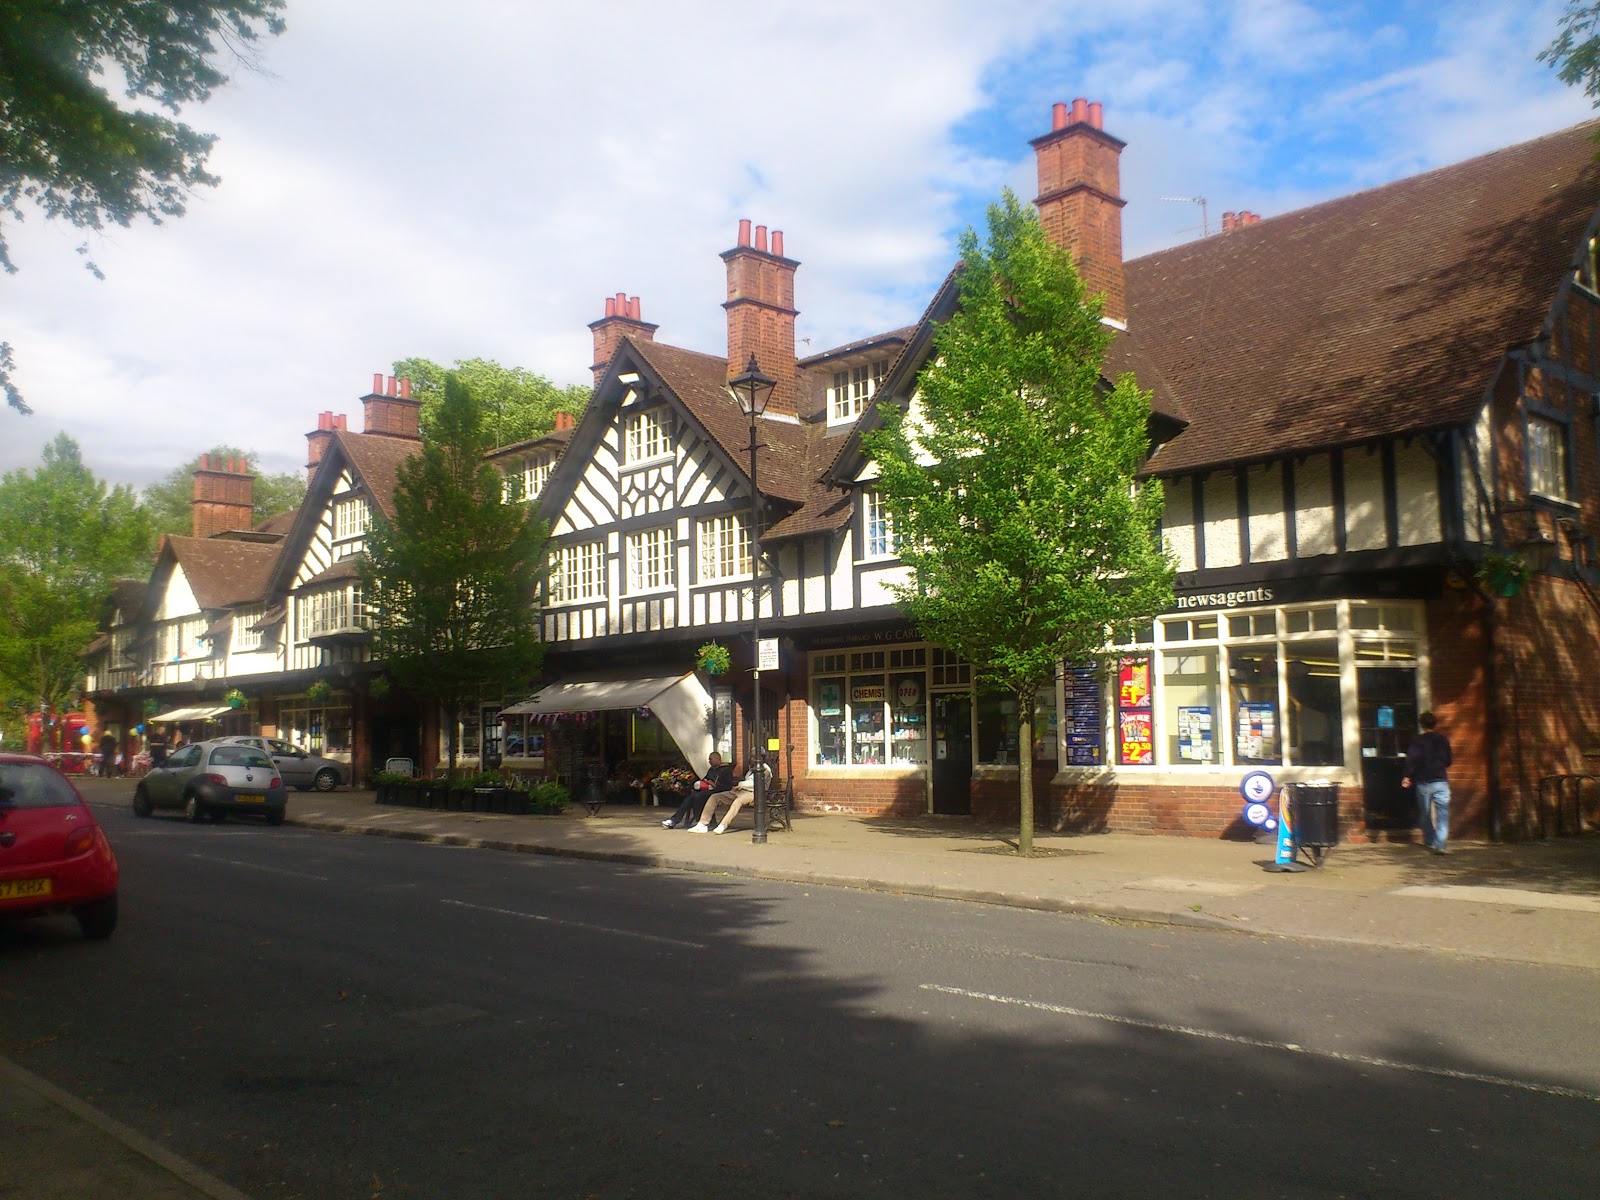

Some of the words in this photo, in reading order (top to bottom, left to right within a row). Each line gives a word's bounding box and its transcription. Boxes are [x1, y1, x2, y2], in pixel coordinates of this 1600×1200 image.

[1177, 586, 1274, 608] newsagents
[853, 688, 885, 699] CHEMIST
[899, 688, 917, 697] OPEN
[1121, 685, 1137, 704] £1
[1122, 742, 1152, 761] £2.50
